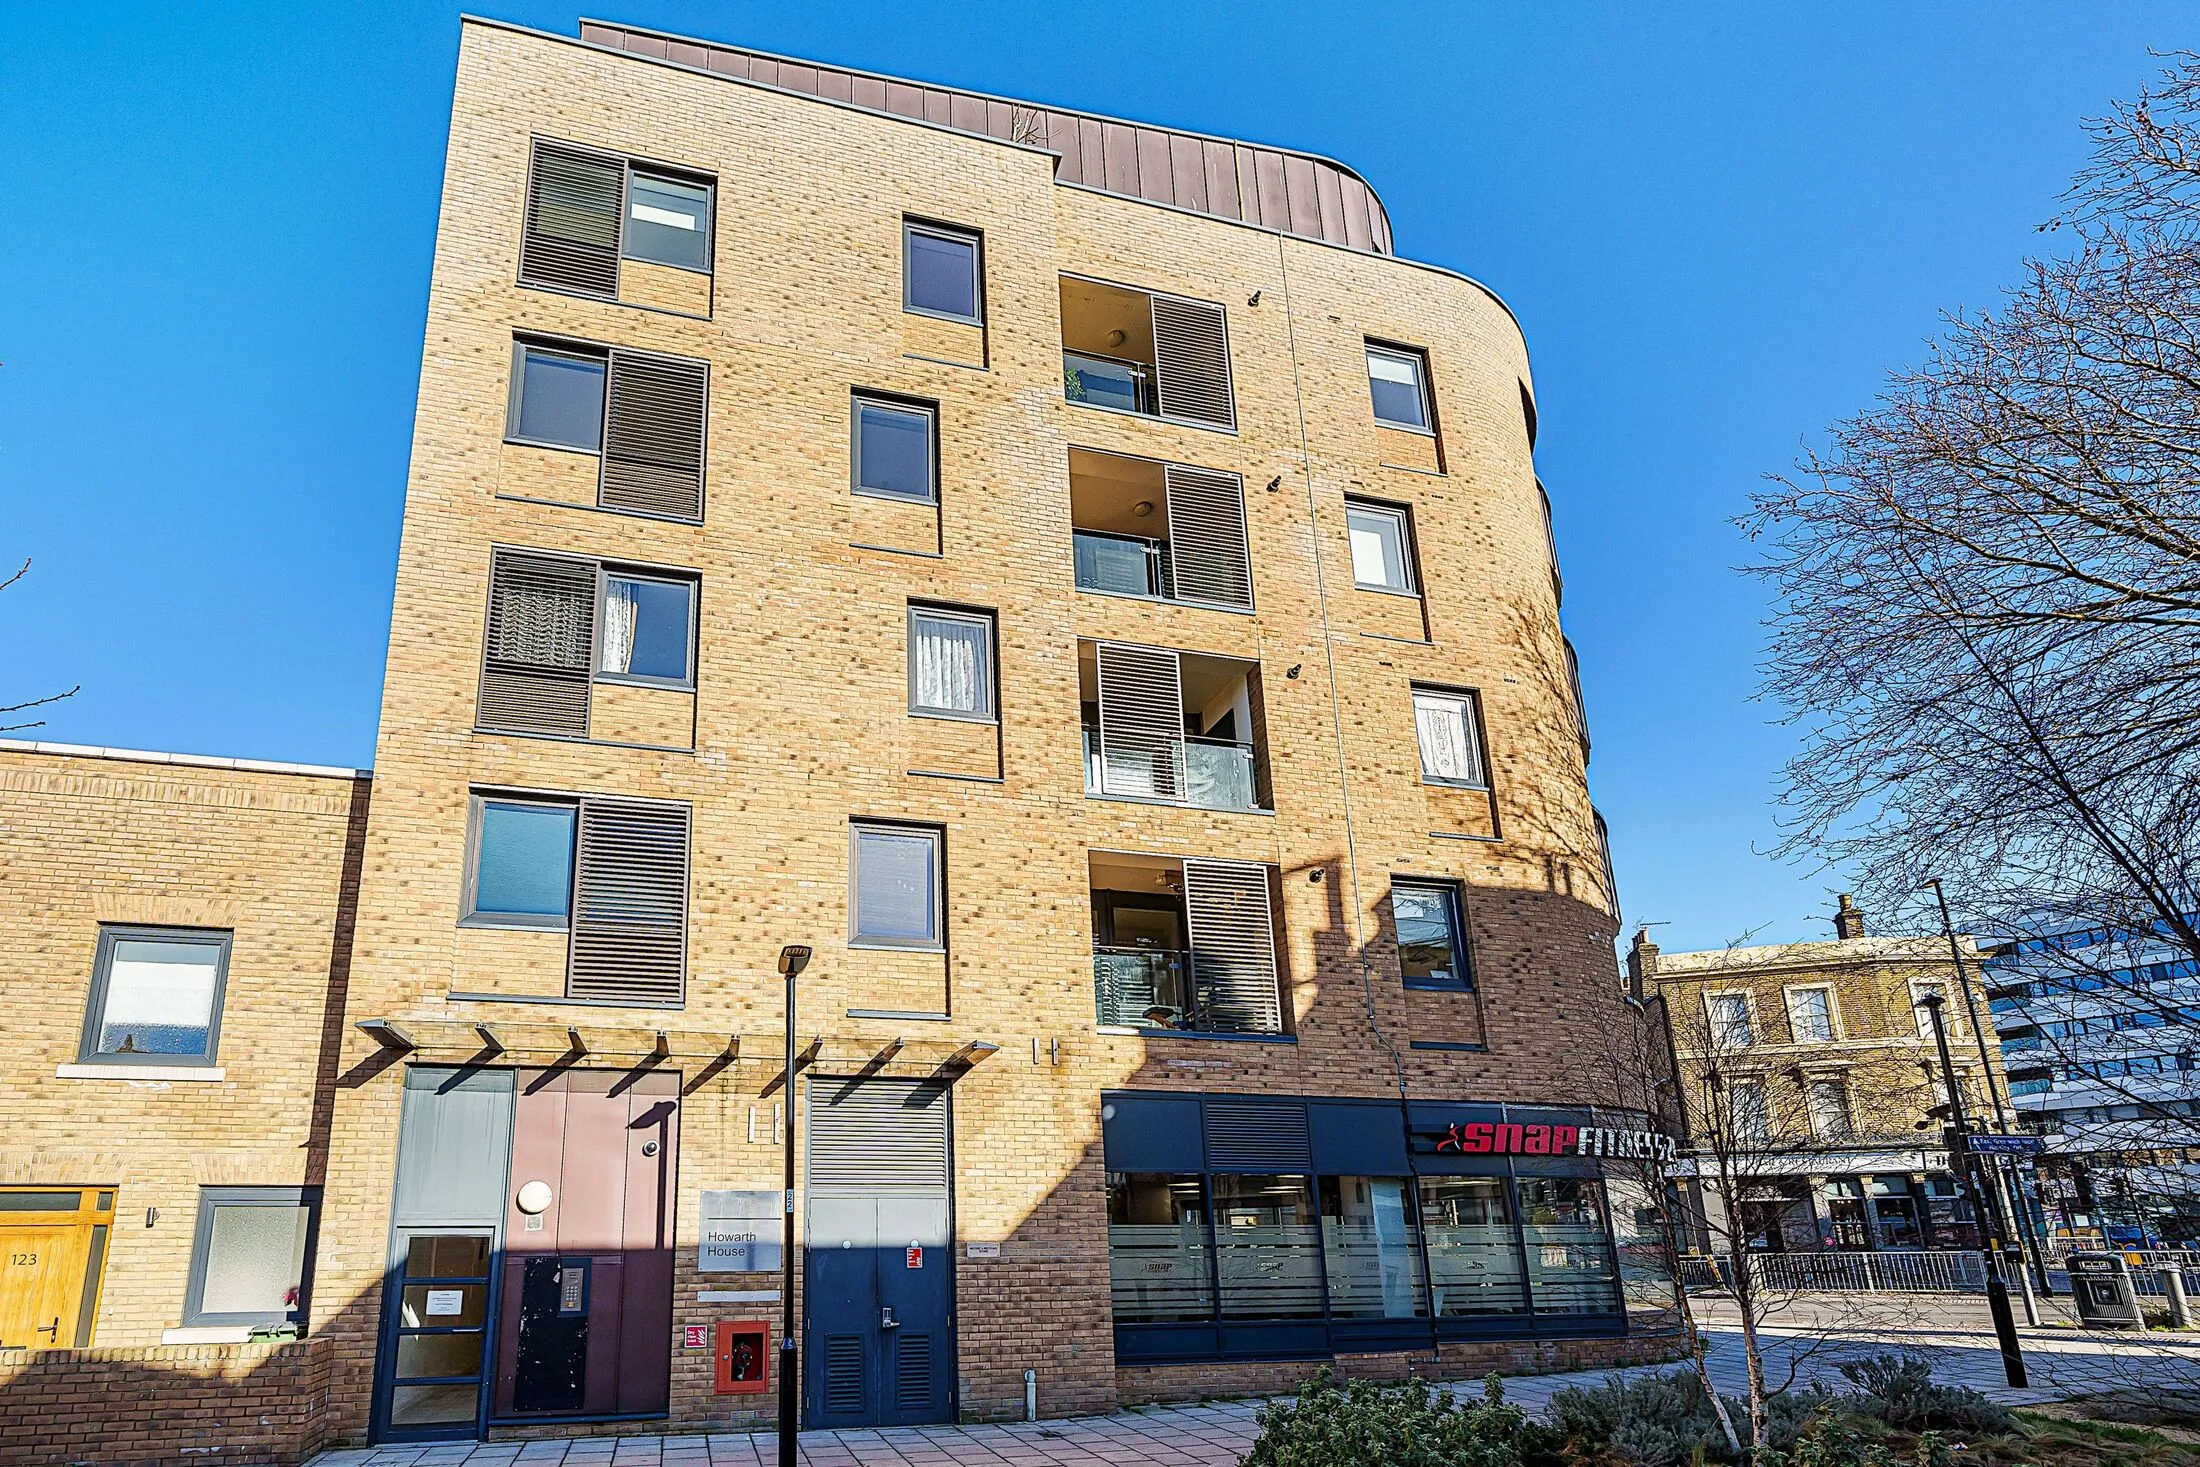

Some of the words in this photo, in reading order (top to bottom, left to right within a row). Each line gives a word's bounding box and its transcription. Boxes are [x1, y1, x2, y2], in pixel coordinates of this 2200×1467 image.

[708, 1232, 757, 1242] Howarth
[708, 1246, 745, 1257] House
[12, 1254, 37, 1266] 123
